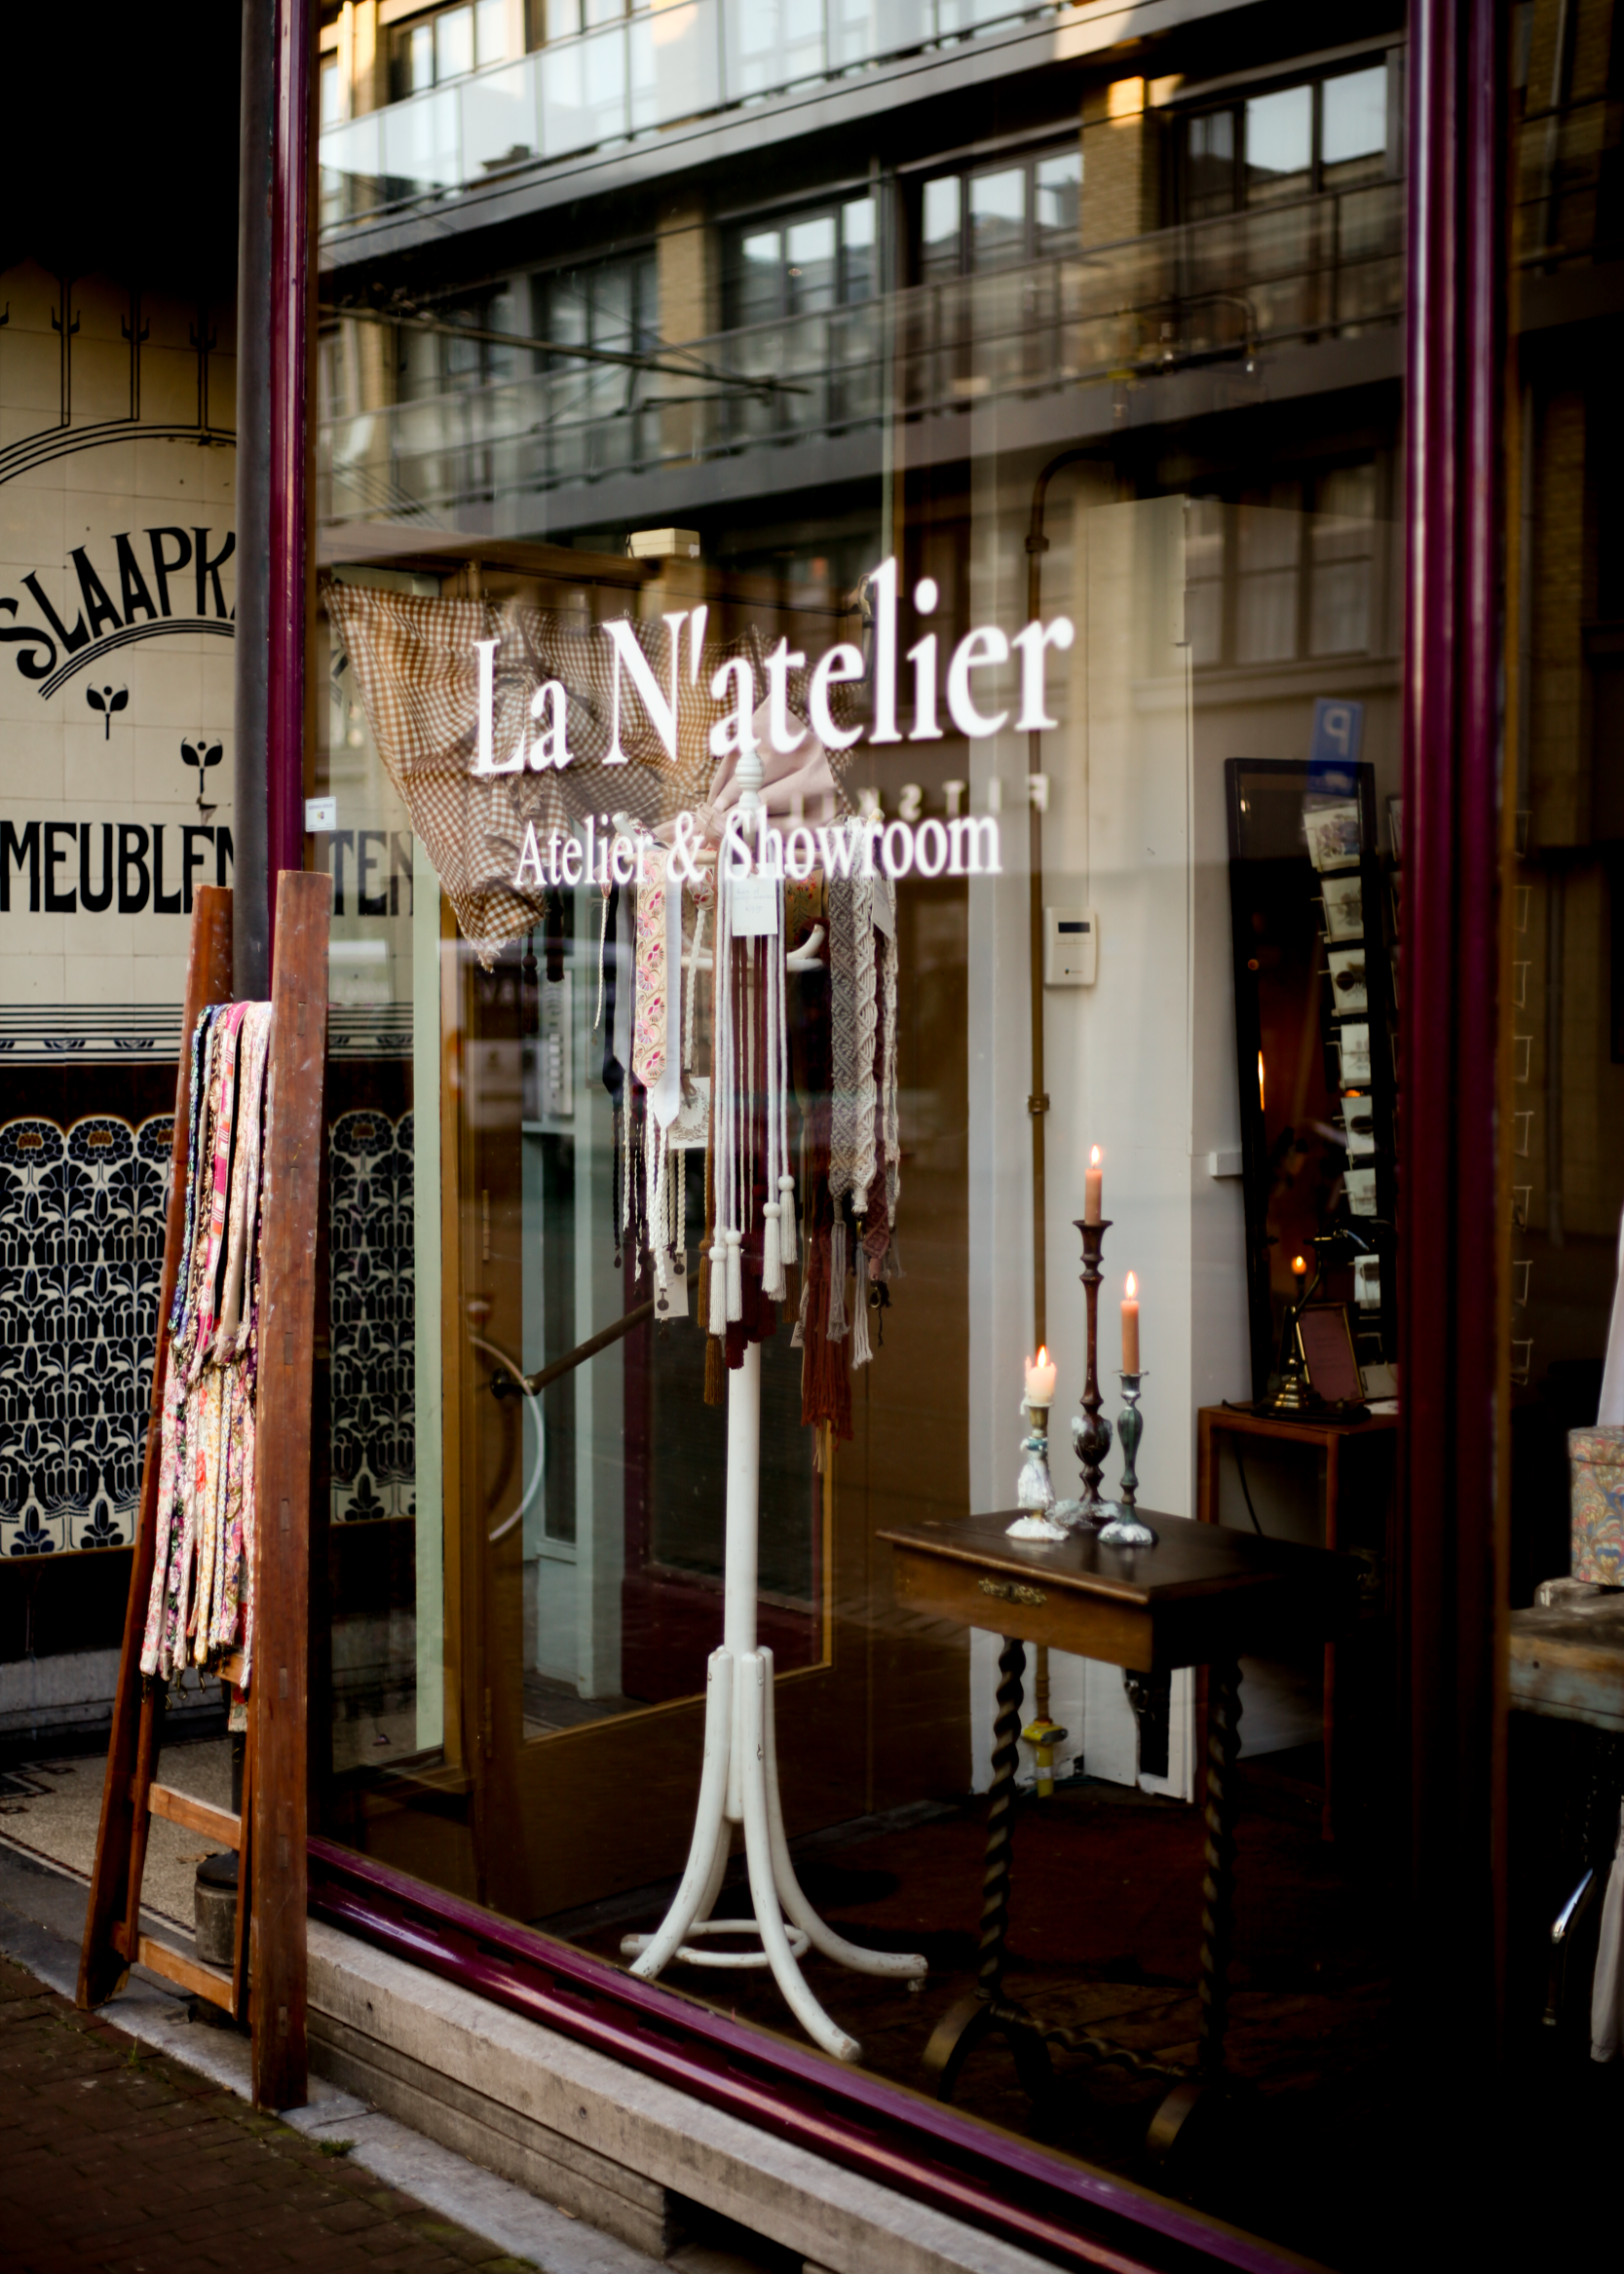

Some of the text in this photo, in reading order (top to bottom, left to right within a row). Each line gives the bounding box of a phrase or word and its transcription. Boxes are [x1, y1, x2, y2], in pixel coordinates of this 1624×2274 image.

[0, 526, 236, 680] SLAAPK
[472, 556, 1075, 777] La N'atelier
[514, 804, 1002, 886] Atelier & Showroom
